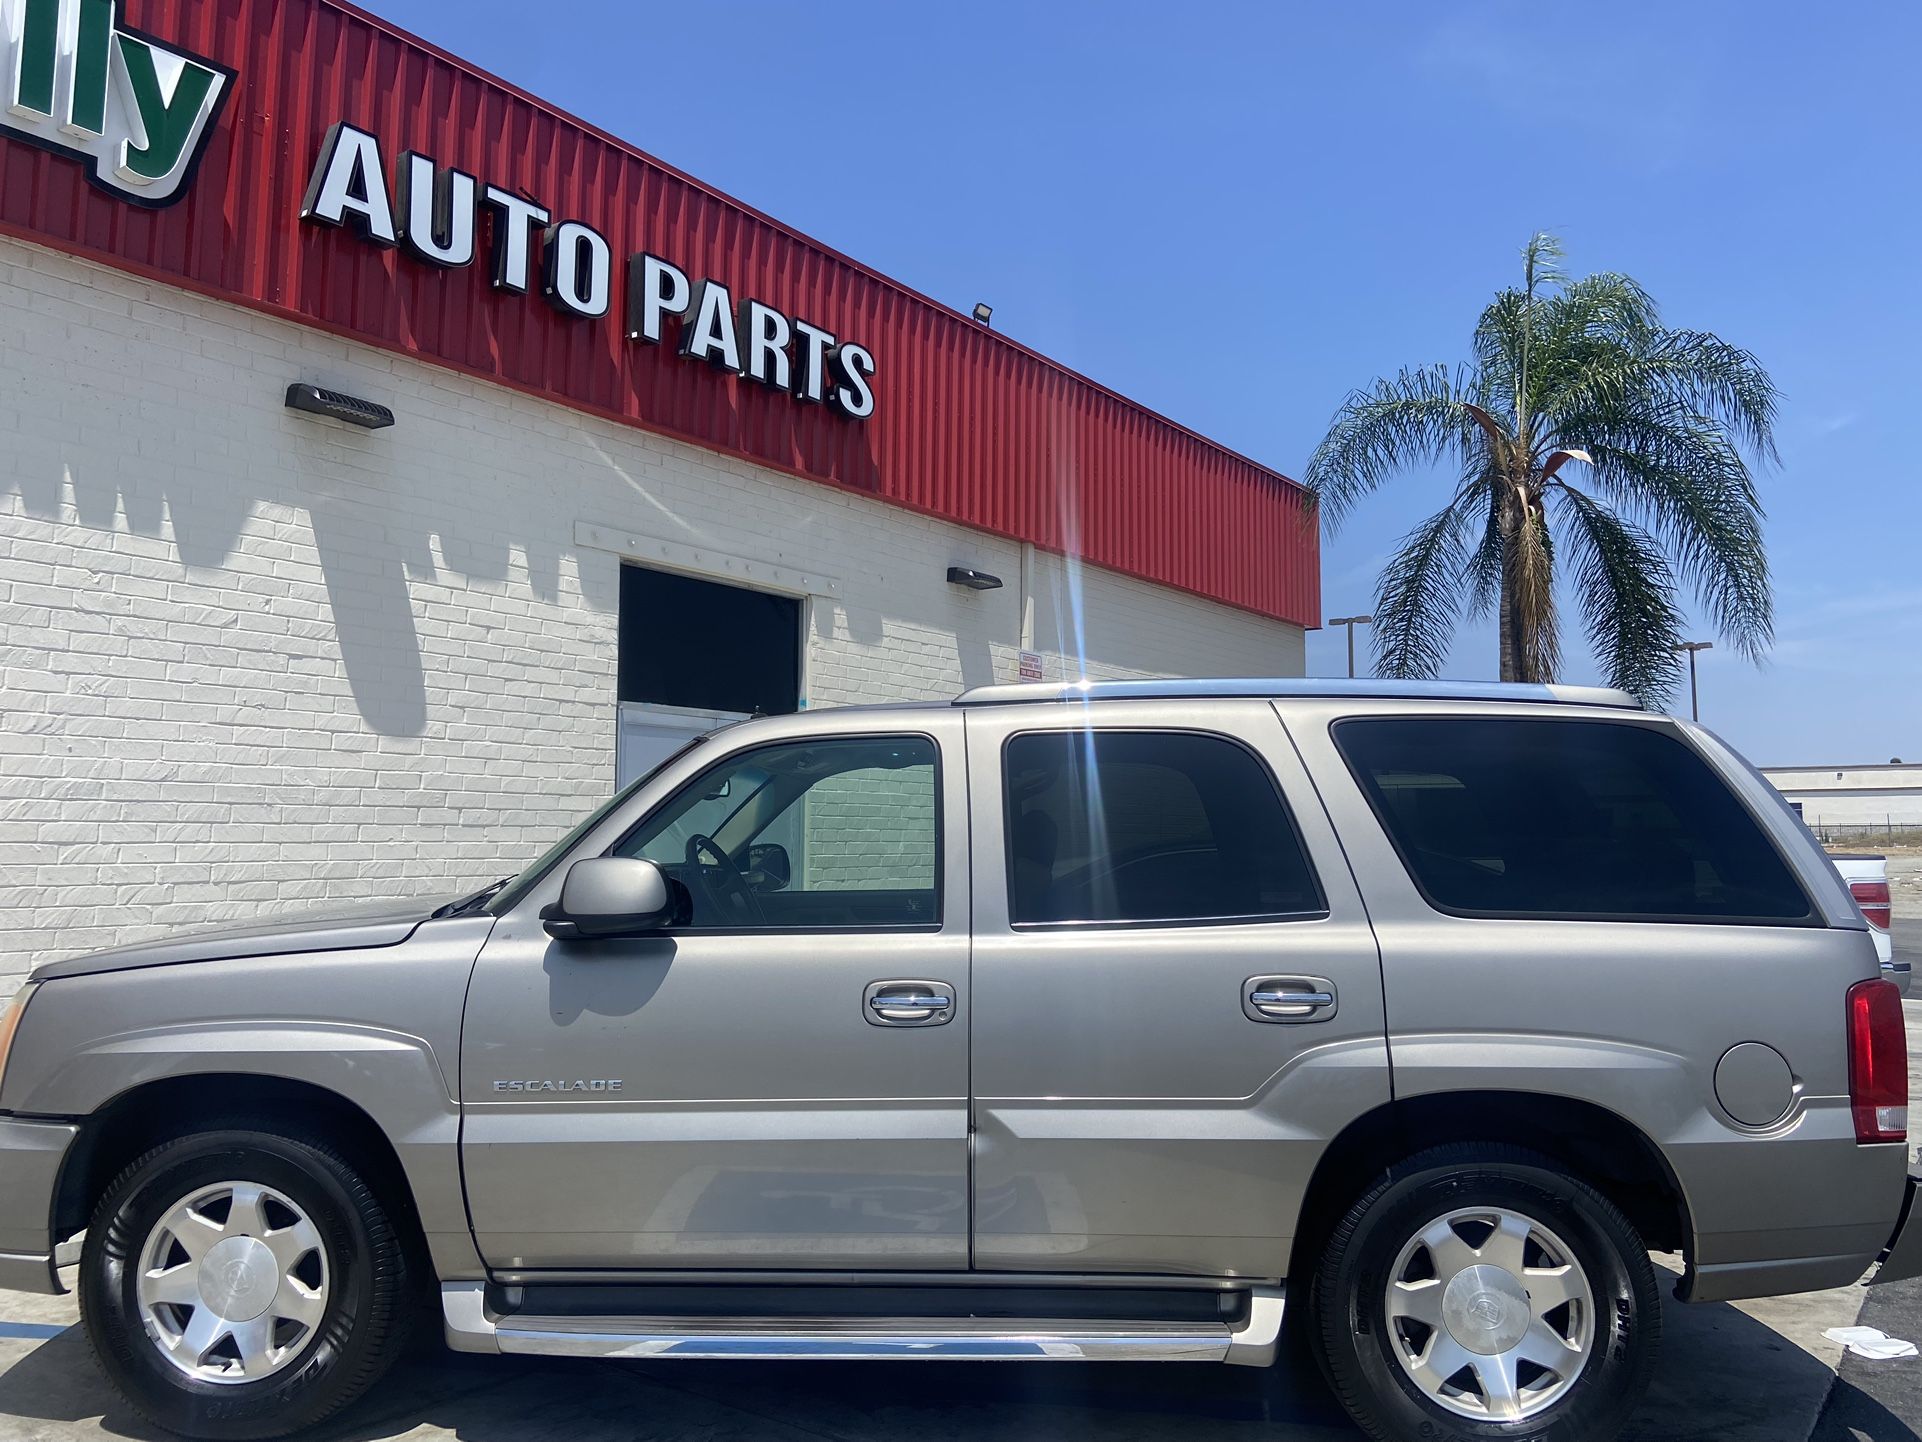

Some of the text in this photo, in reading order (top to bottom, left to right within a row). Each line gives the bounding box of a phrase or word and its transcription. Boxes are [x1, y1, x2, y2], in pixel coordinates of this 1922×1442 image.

[302, 121, 875, 420] AUTO PARTS
[493, 1079, 623, 1092] ESCALADE
